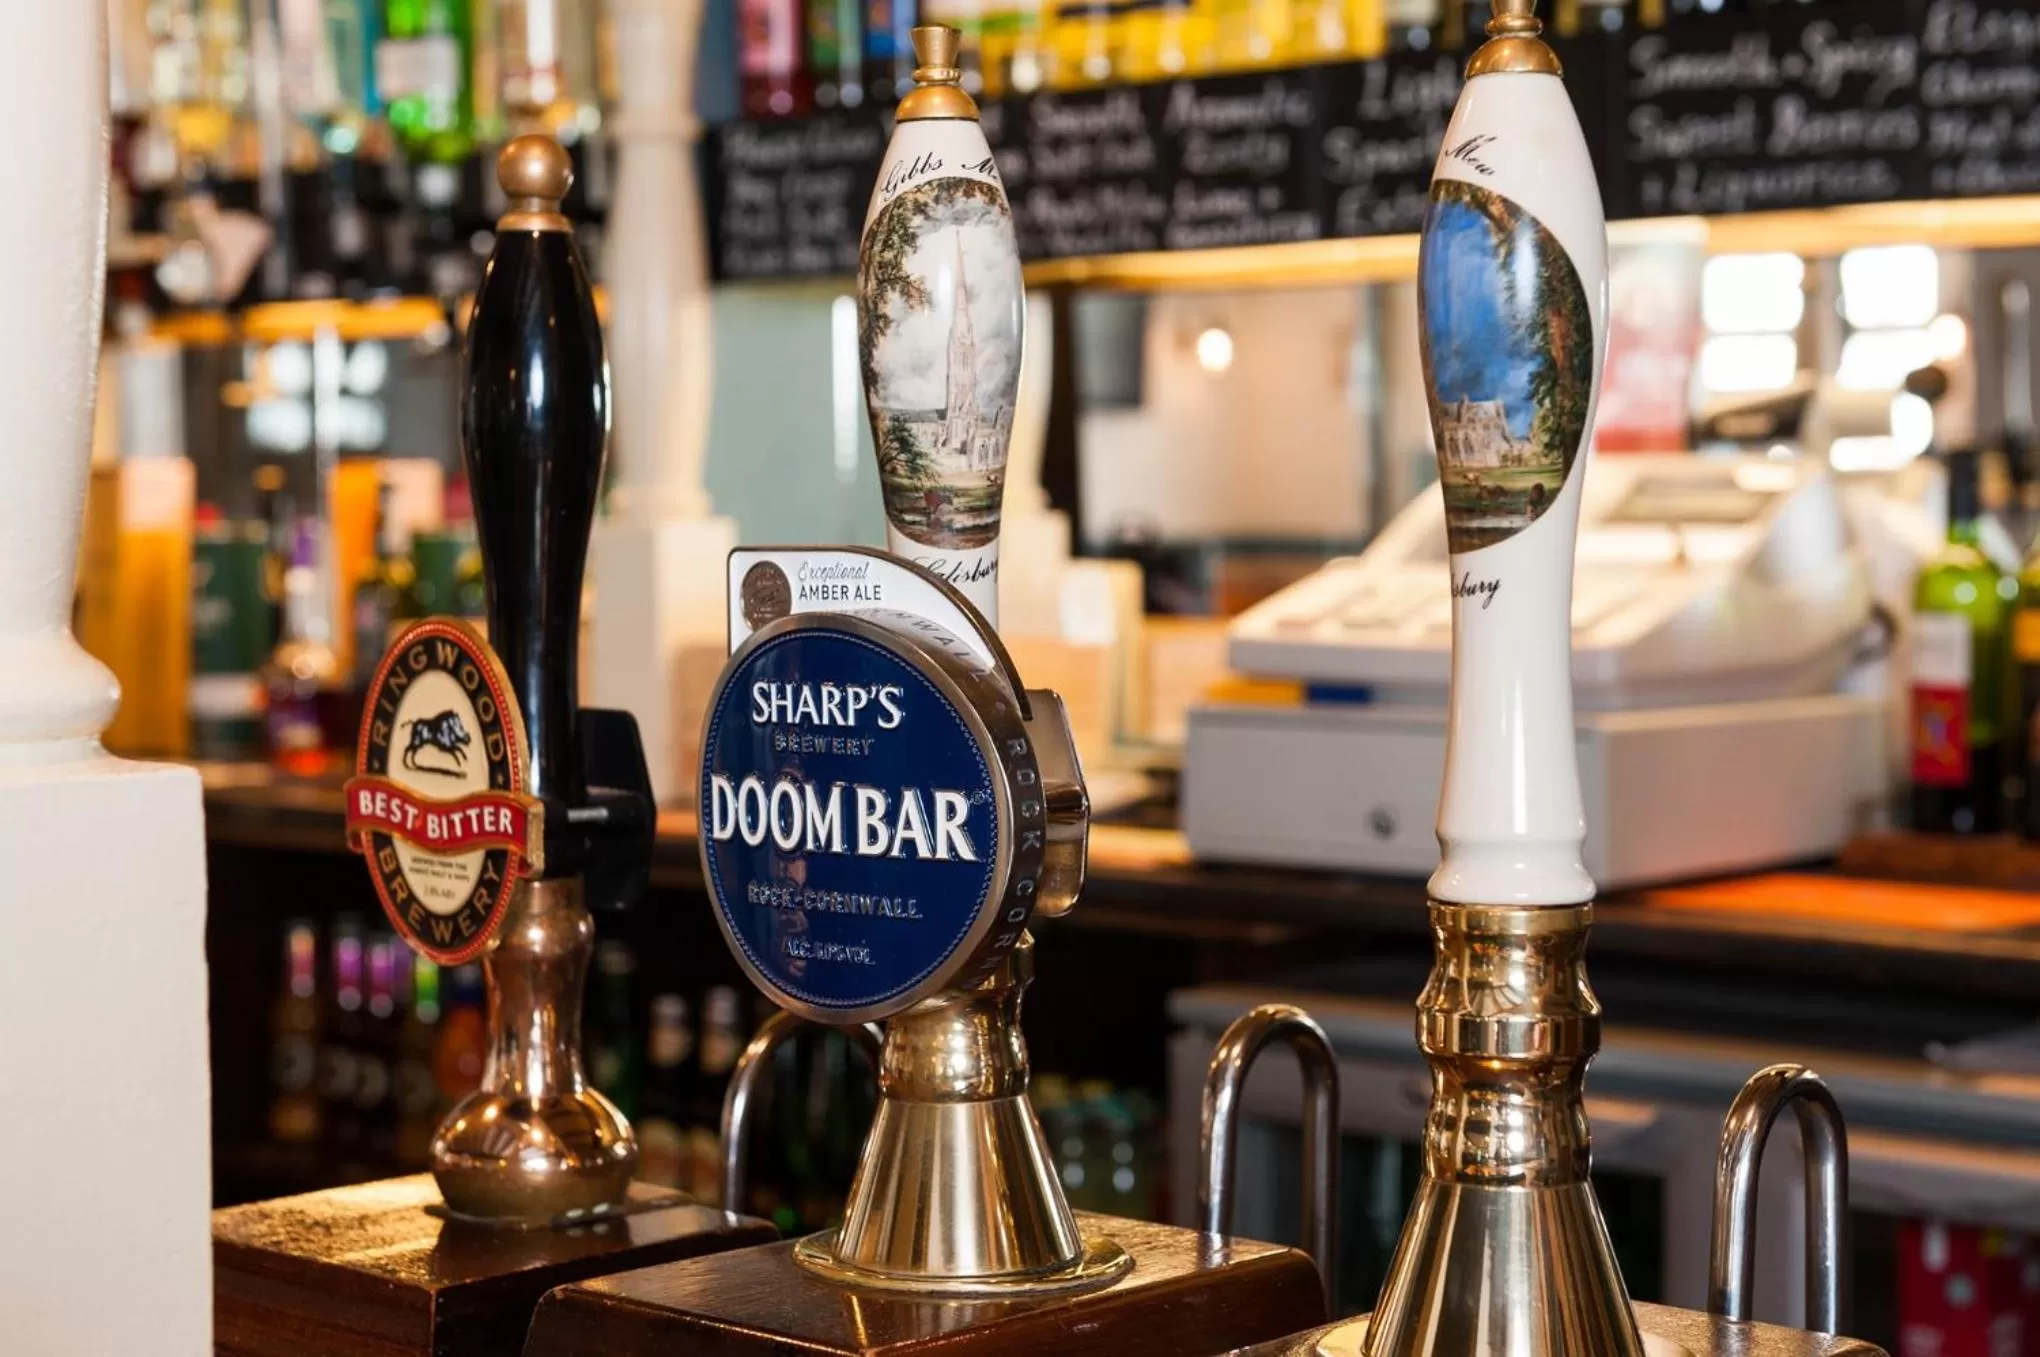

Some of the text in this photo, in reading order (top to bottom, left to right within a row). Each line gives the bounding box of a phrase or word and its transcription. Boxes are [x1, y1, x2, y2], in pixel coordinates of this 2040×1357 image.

[881, 151, 944, 202] Gibbs
[797, 560, 871, 581] Exceptional
[798, 584, 882, 601] AMBER ALE
[372, 640, 505, 762] RINGWOOD
[751, 679, 907, 730] SHARP'S
[774, 730, 876, 756] BREWERY
[358, 789, 514, 841] BEST BITTER
[709, 774, 981, 862] DOOM BAR
[378, 846, 501, 945] BREWERY
